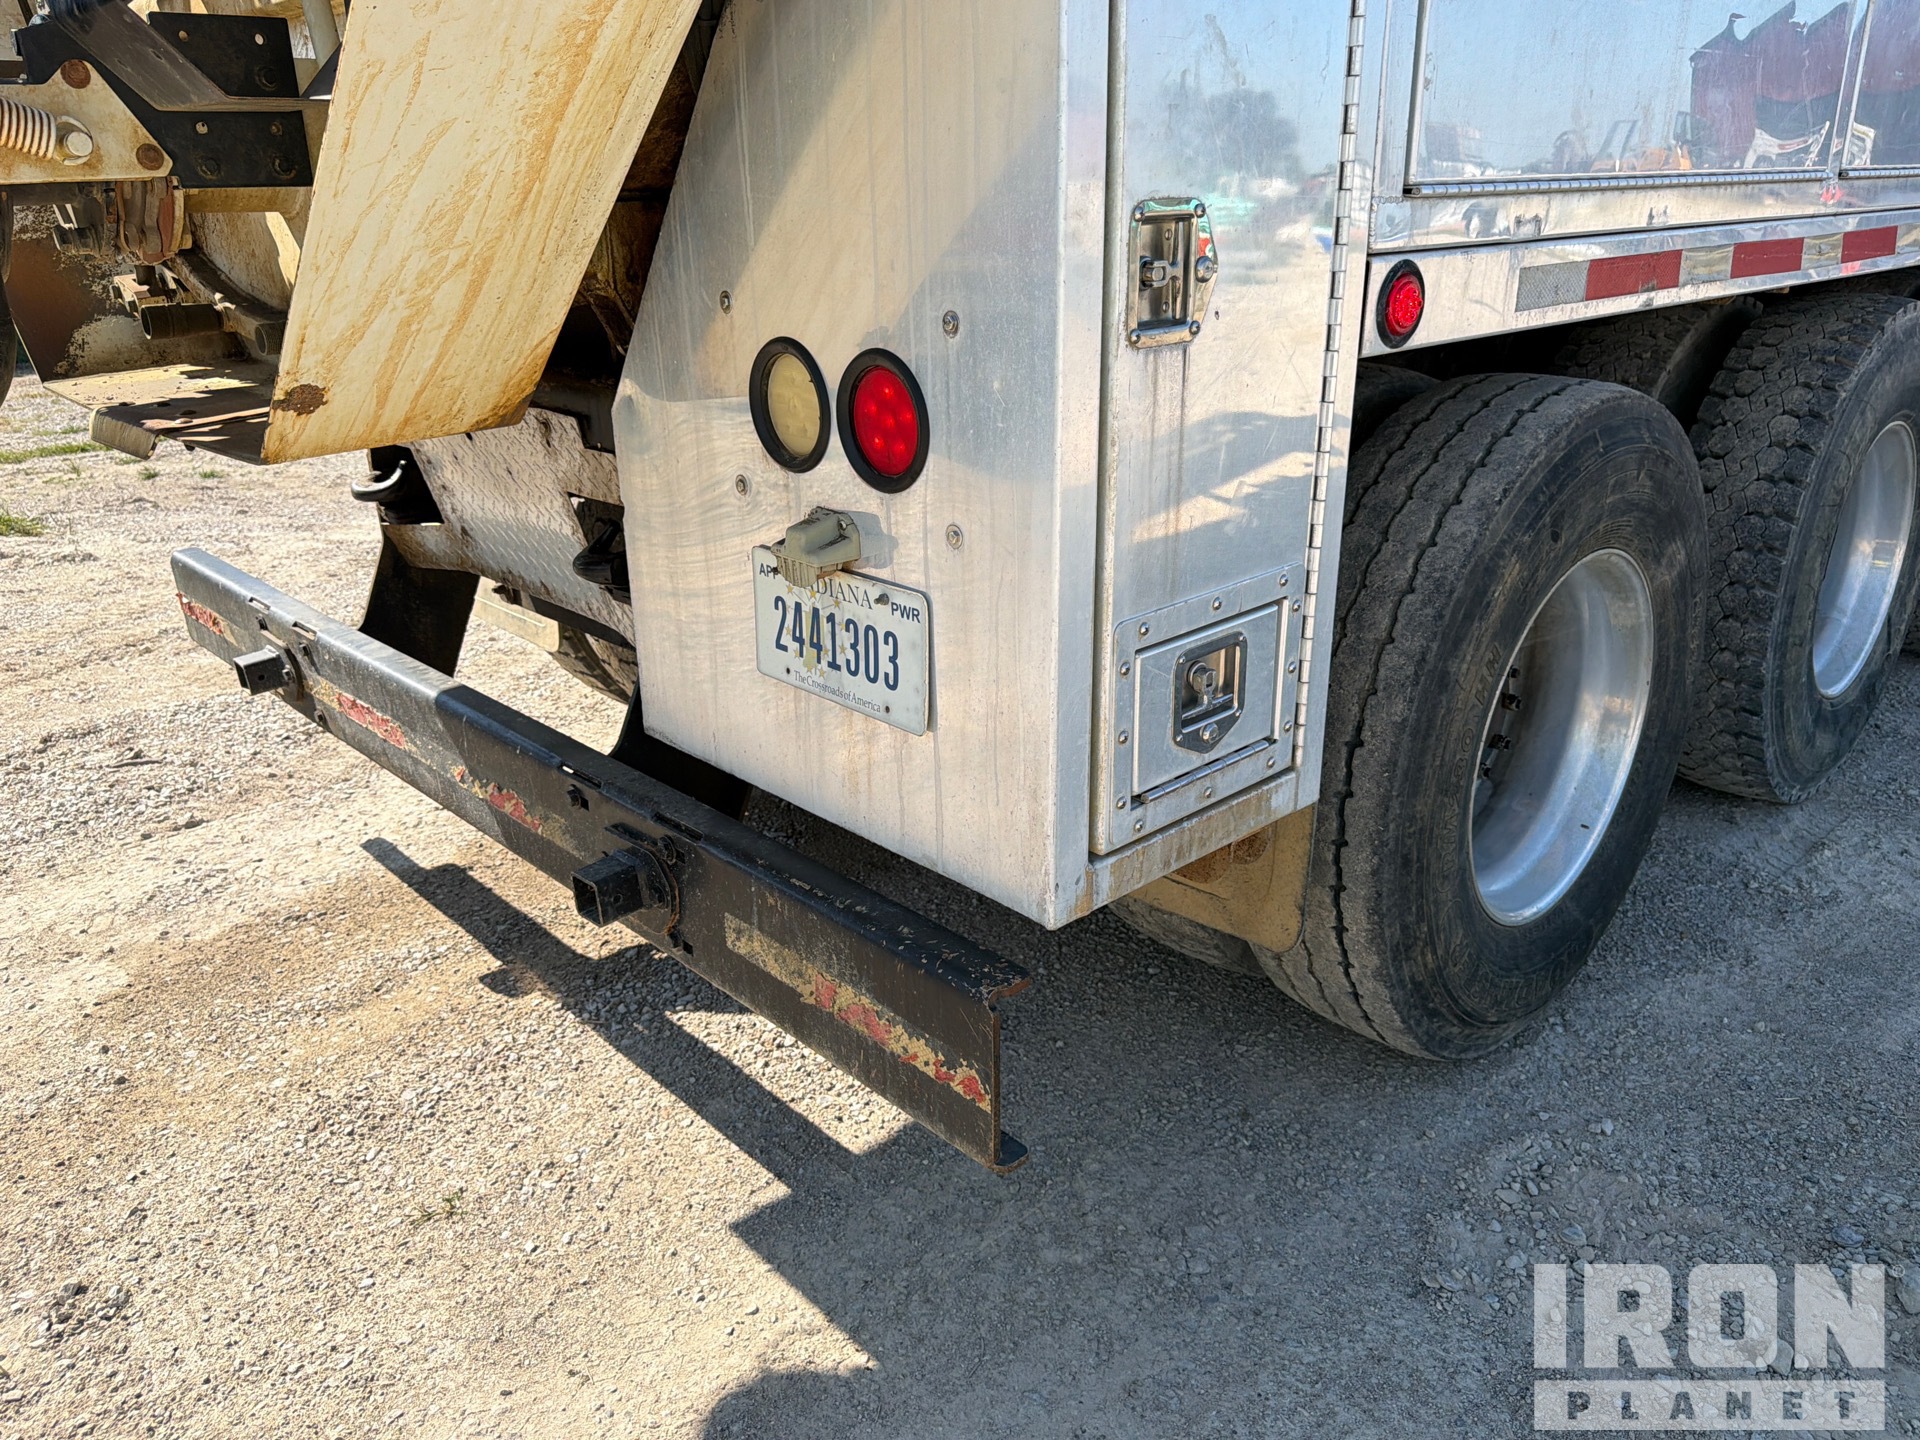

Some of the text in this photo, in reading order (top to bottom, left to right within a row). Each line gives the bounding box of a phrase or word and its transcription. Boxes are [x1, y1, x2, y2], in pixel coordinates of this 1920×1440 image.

[810, 577, 873, 610] DIANA
[891, 602, 921, 623] PWR
[774, 595, 900, 691] 2441303
[794, 669, 881, 713] The Crossroads of America
